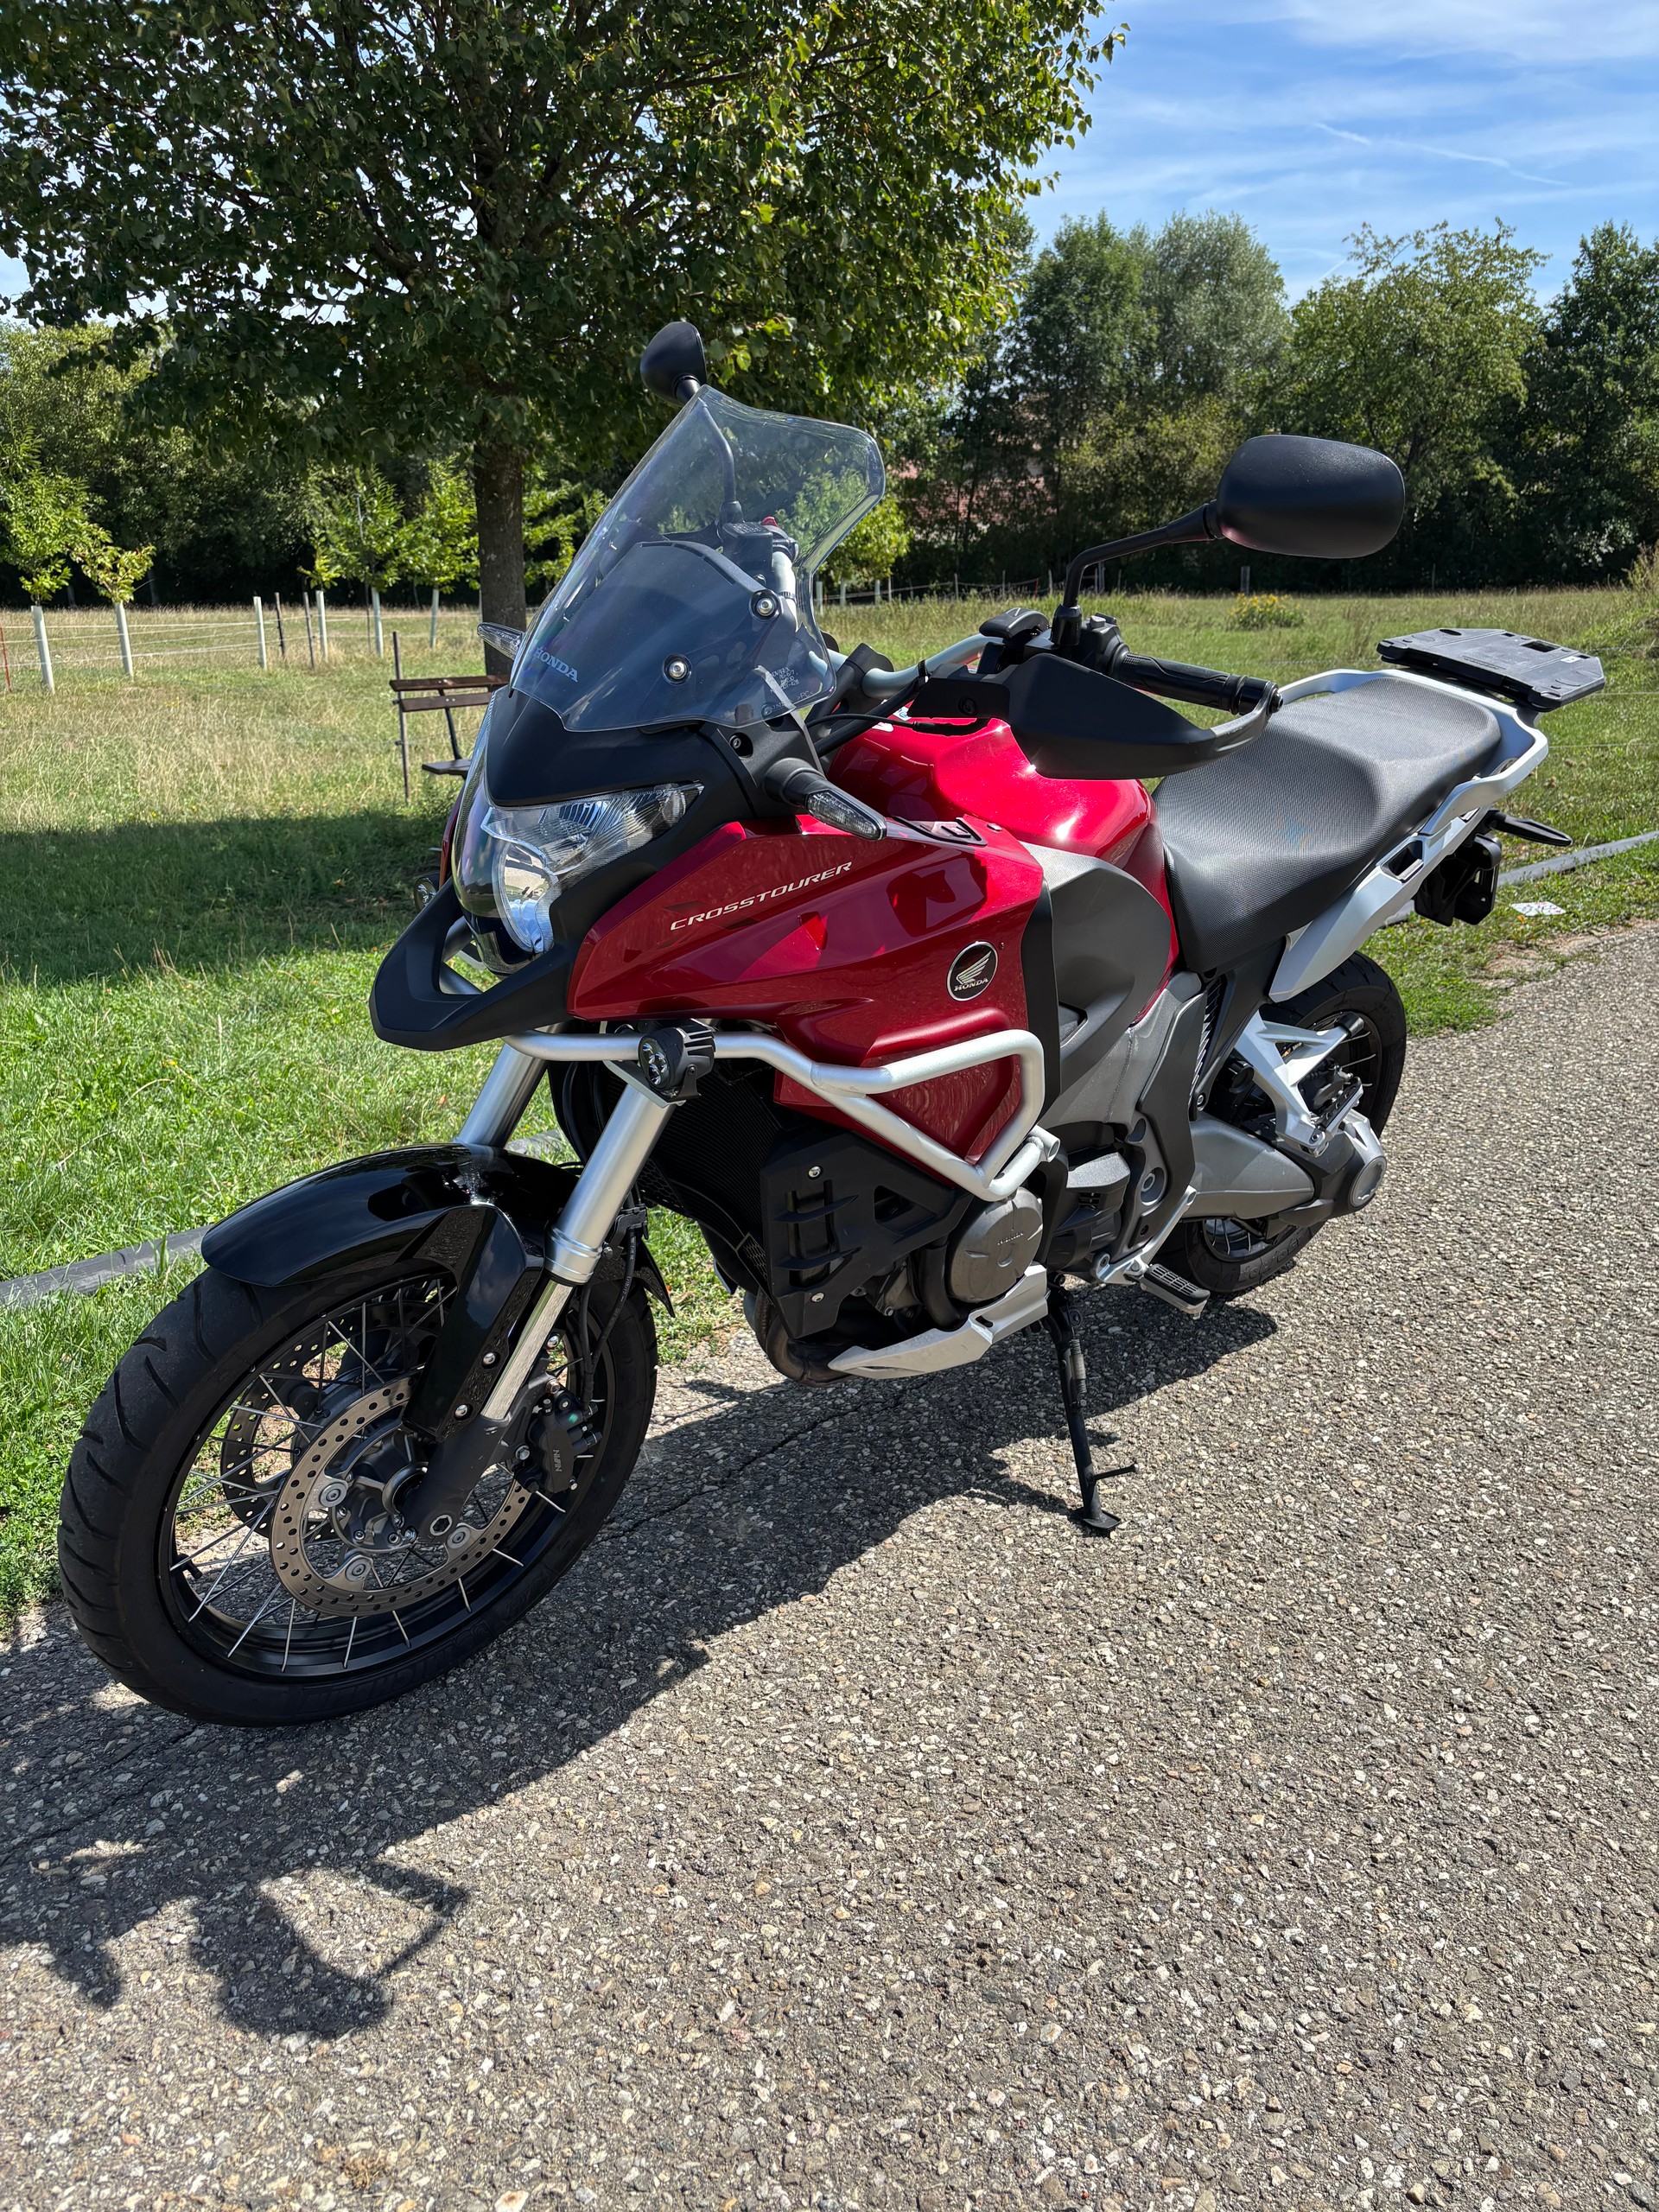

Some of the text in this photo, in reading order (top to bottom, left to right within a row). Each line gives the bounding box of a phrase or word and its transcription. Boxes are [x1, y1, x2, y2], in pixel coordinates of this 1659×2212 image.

[534, 645, 578, 683] HONDA
[671, 861, 852, 931] CROSSTOURER
[954, 977, 988, 992] HONDA
